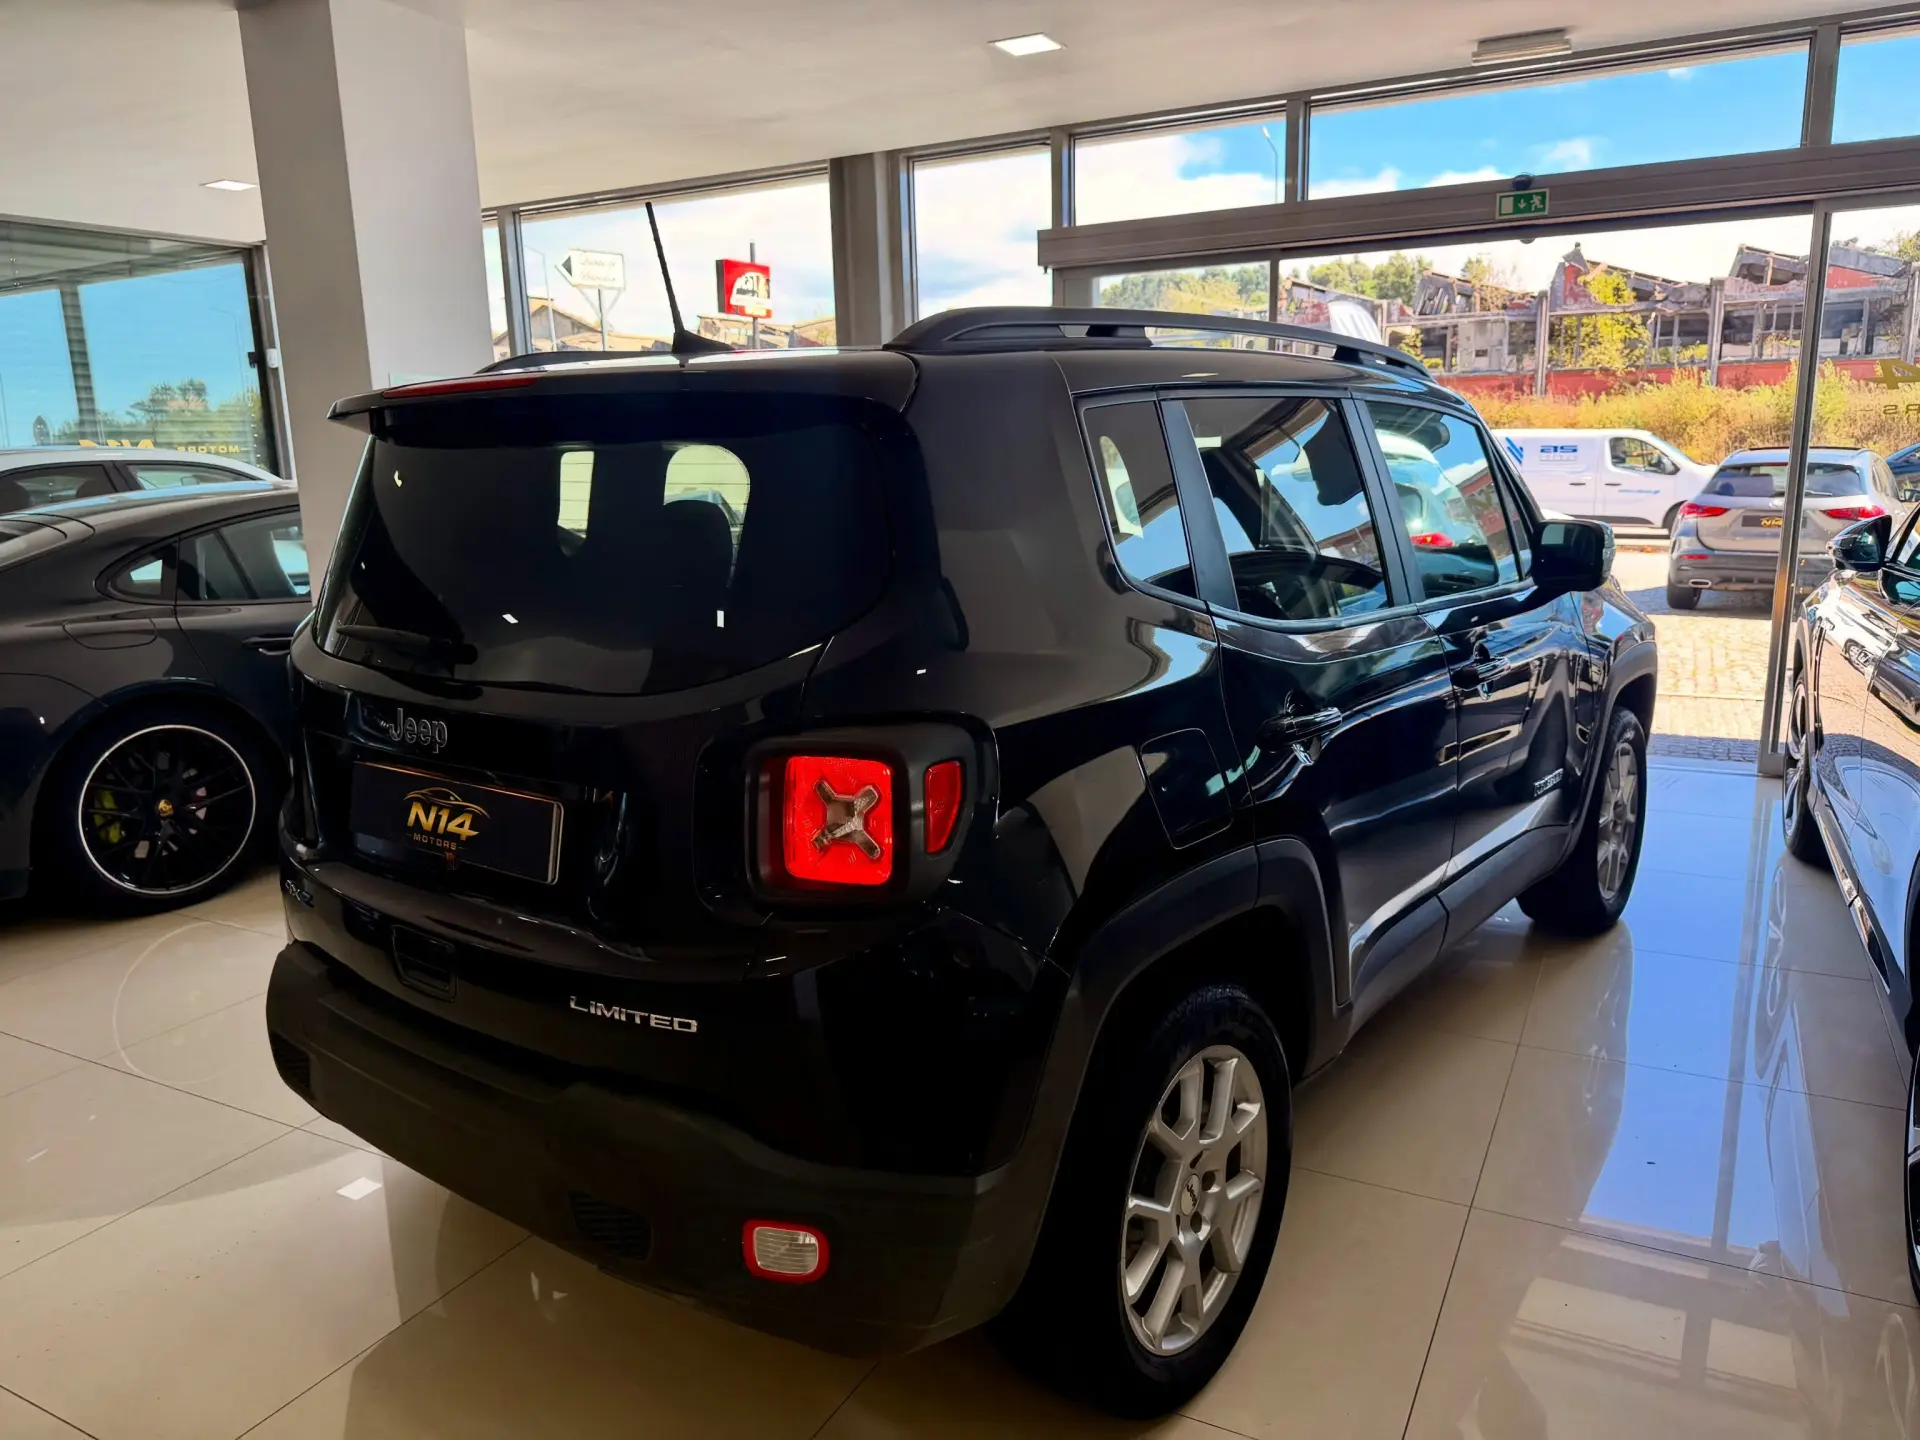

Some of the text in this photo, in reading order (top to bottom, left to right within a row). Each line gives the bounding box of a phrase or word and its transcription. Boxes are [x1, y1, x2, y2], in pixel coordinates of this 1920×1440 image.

[389, 708, 448, 753] Jeep
[407, 801, 479, 841] N14
[412, 832, 457, 851] MOTORS
[569, 996, 699, 1033] LIMITED
